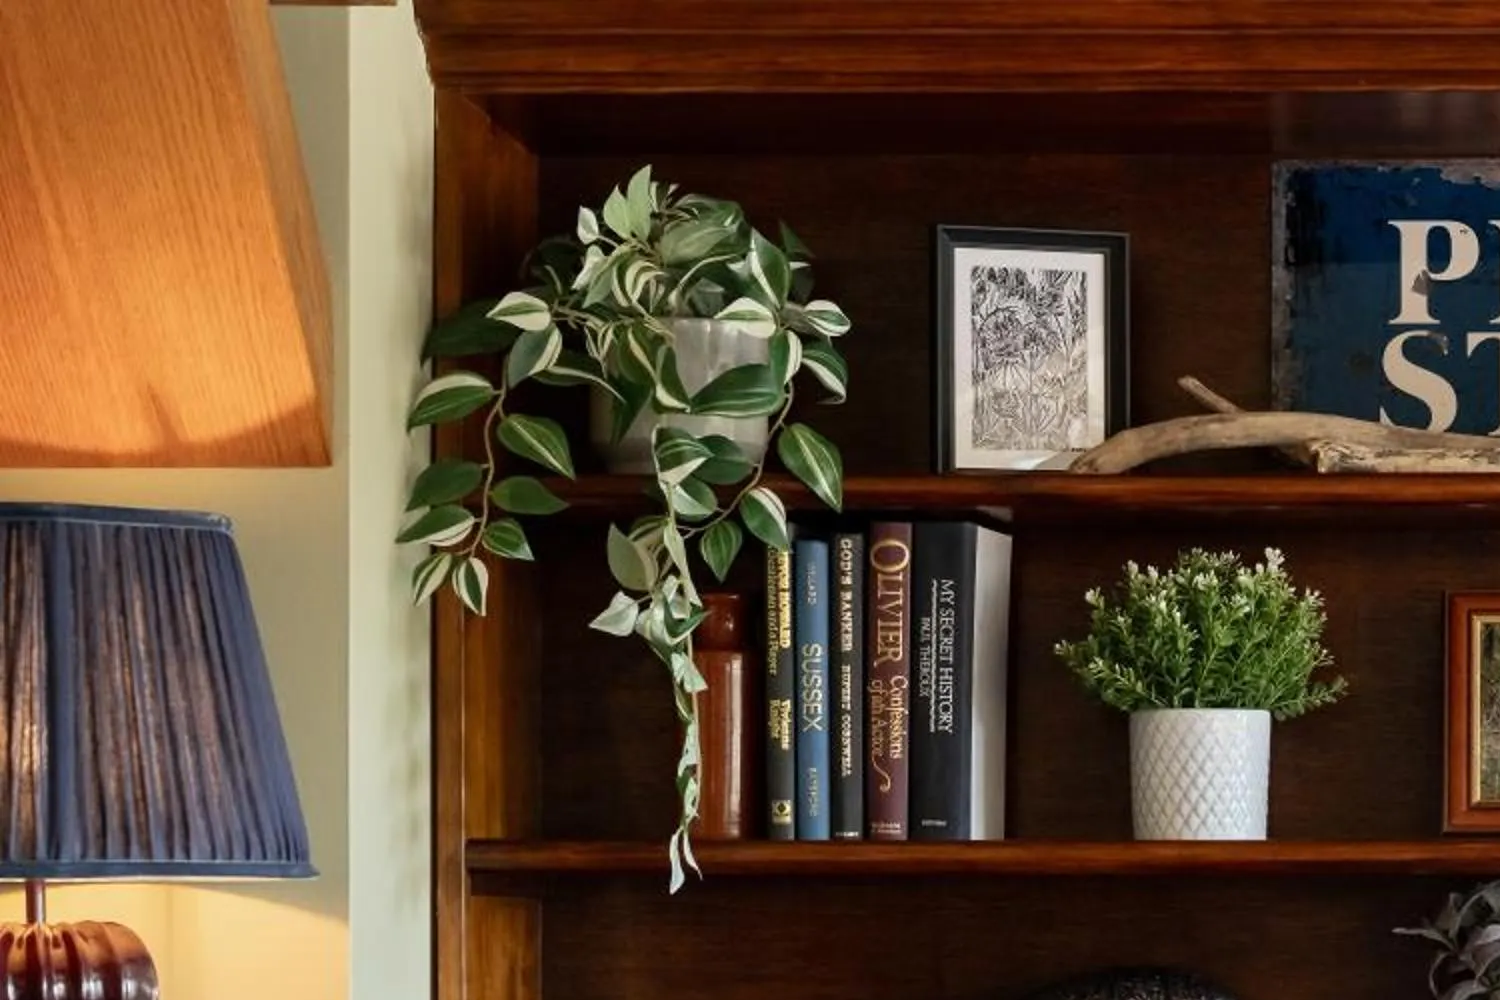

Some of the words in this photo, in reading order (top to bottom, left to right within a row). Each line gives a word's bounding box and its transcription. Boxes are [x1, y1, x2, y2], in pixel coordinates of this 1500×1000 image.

[840, 538, 853, 585] GOD'S
[840, 590, 853, 653] BANKER
[870, 538, 910, 668] OLIVIER
[939, 579, 953, 605] MY
[919, 617, 930, 641] PAUL
[938, 608, 953, 664] SECRET
[801, 643, 824, 732] SUSSEX
[919, 646, 930, 697] THEROUX
[938, 667, 953, 733] HISTORY
[886, 674, 909, 759] Confessions
